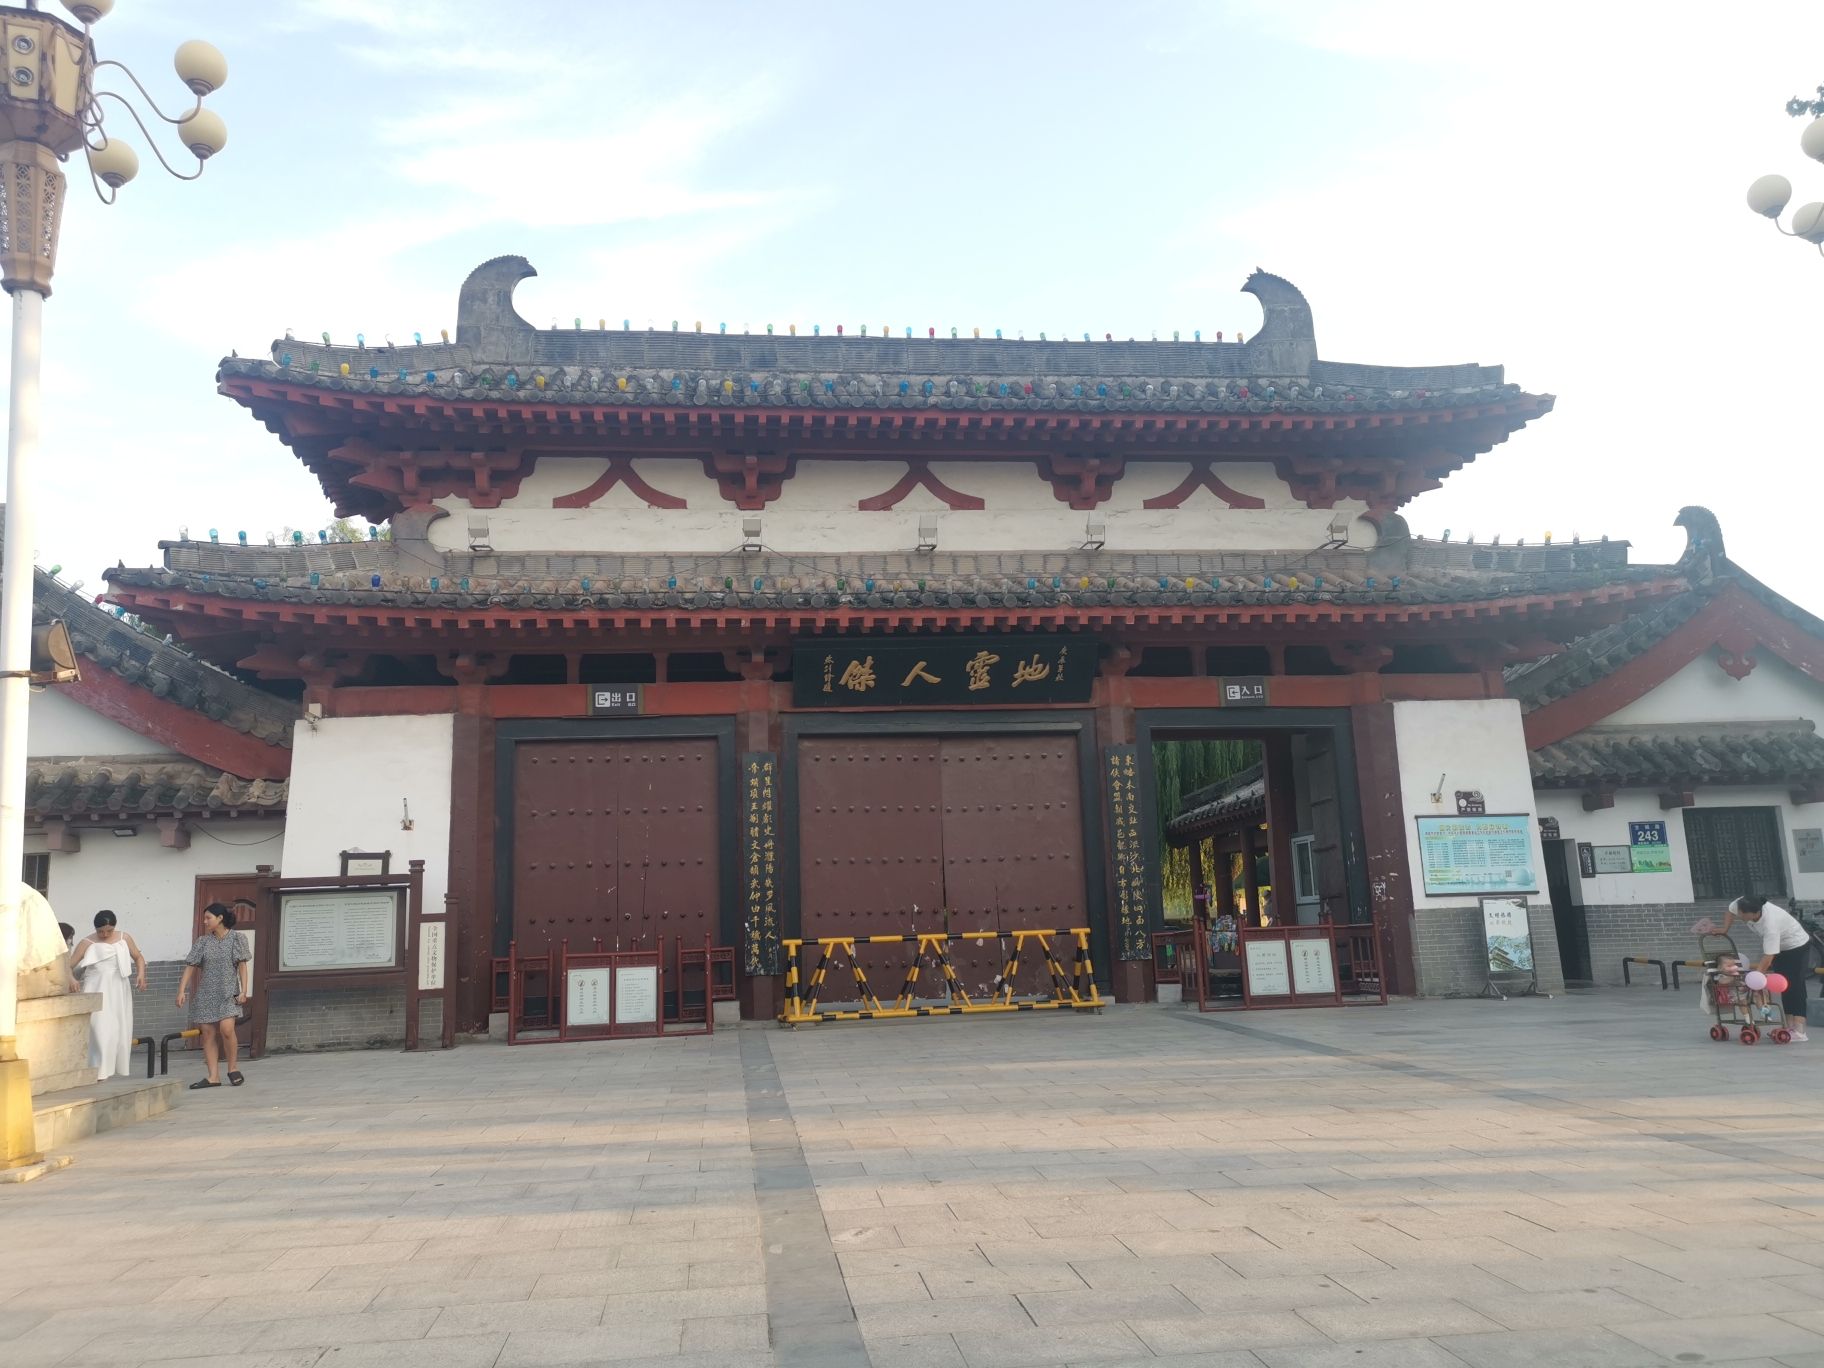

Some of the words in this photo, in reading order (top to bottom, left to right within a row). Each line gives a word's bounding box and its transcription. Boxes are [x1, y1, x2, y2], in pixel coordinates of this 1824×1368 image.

[1241, 685, 1263, 695] 入口
[611, 692, 636, 702] 出口
[1637, 830, 1659, 841] 243
